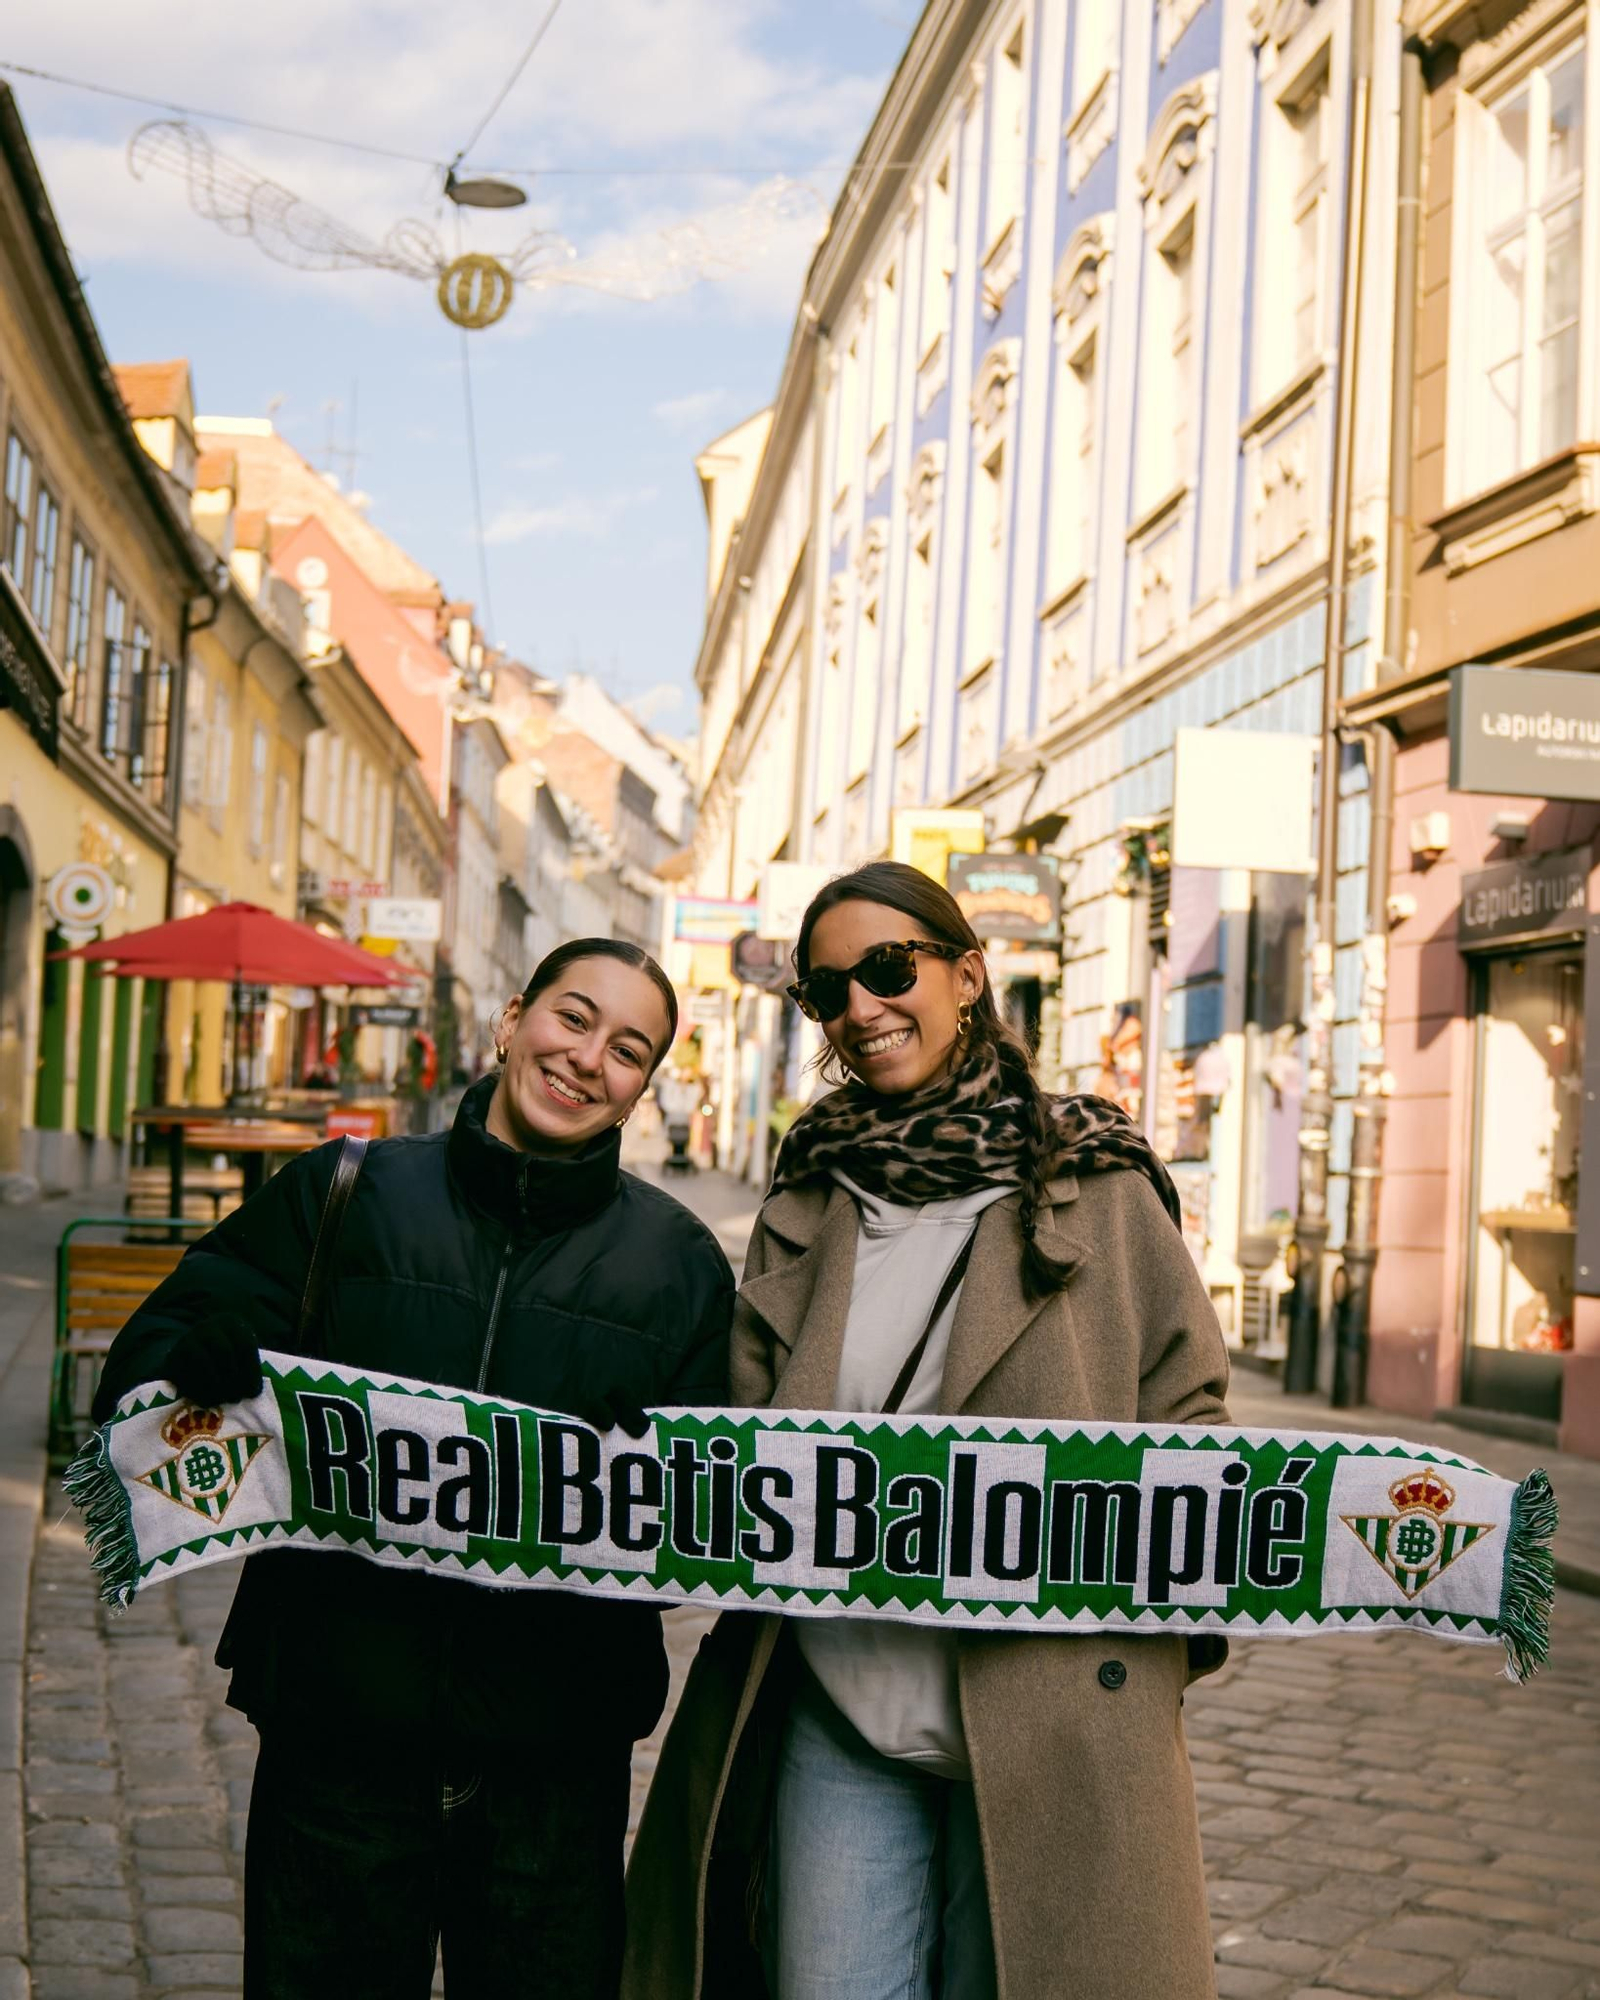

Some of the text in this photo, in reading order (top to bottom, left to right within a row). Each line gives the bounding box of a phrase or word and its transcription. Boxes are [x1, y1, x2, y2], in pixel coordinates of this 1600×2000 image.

[1464, 874, 1585, 931] Lapidarium
[296, 1391, 1316, 1604] Real Betis Balompié
